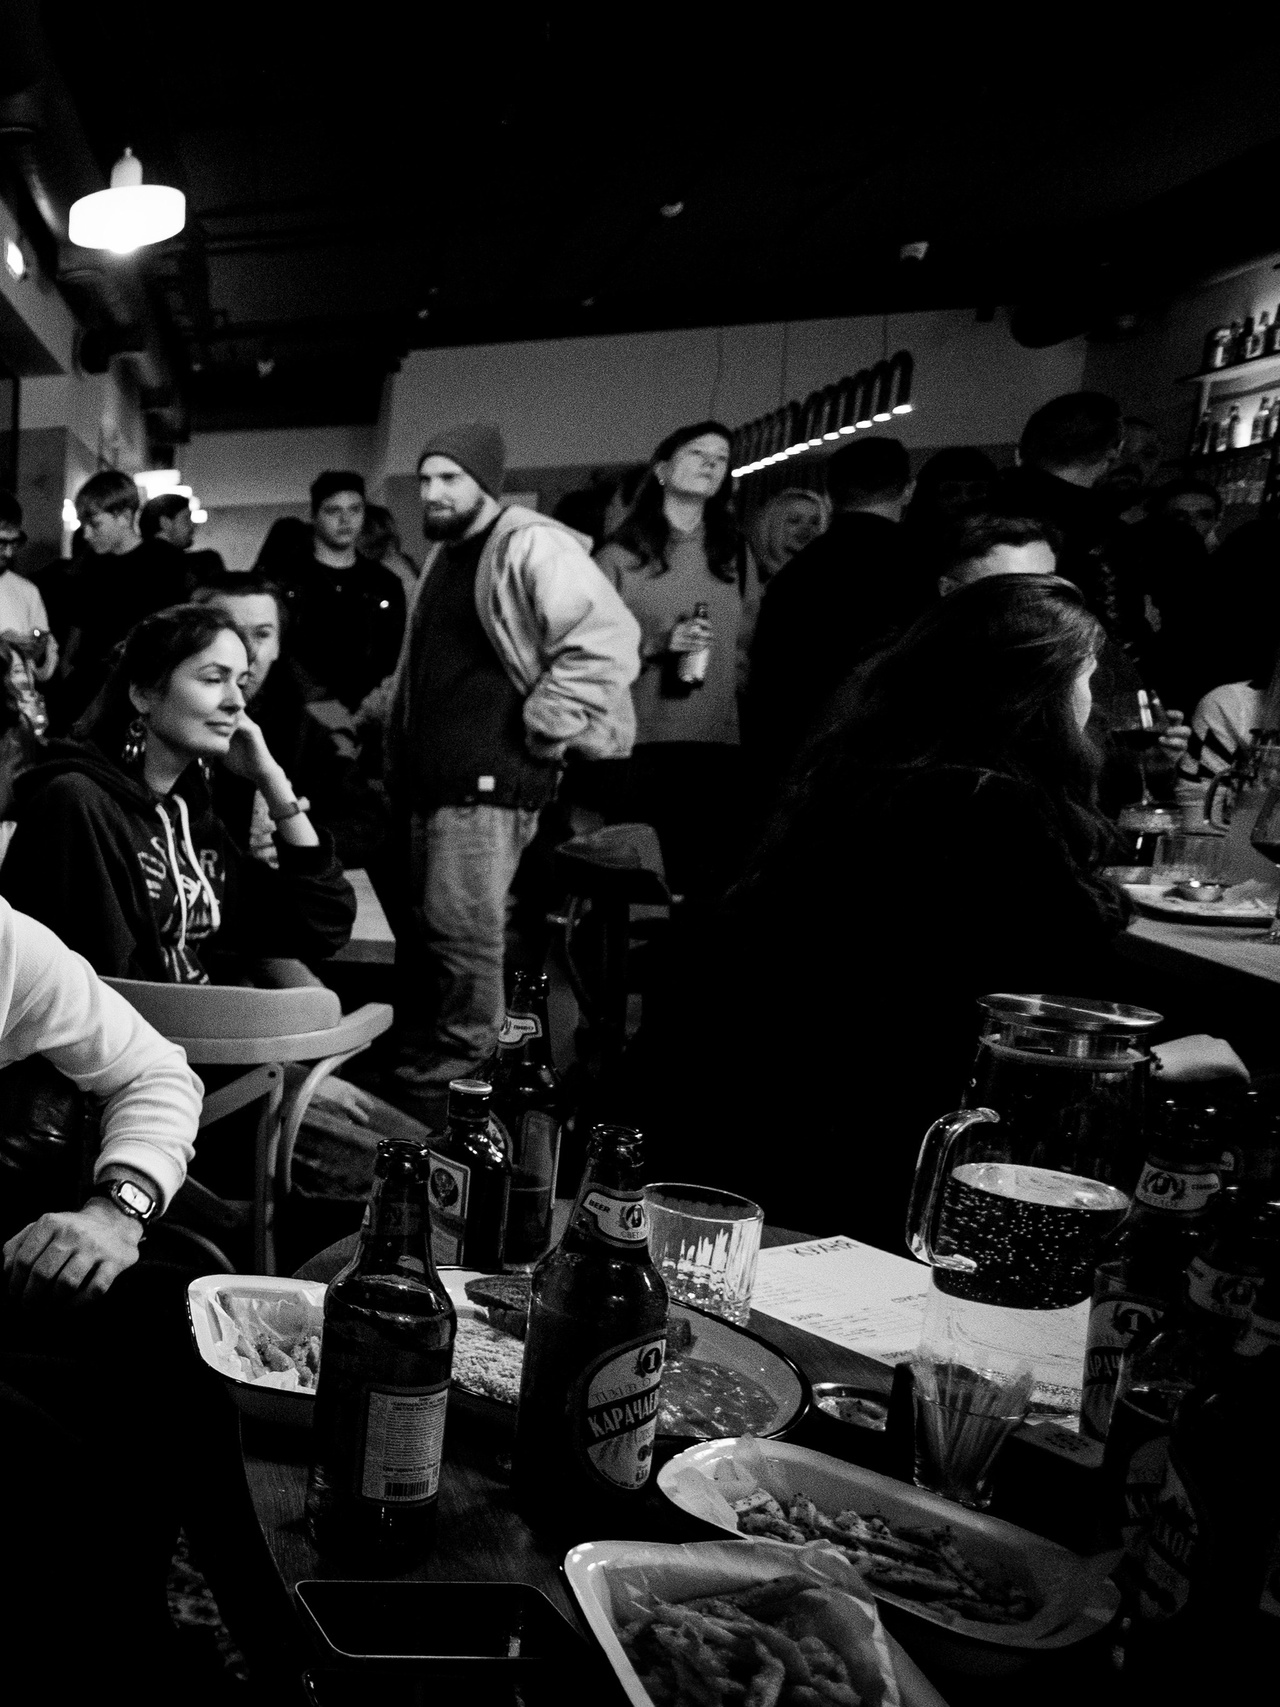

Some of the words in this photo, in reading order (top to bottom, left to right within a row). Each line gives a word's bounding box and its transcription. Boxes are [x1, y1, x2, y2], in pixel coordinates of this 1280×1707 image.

[588, 1199, 611, 1213] BEER
[787, 1238, 859, 1258] КУХНЯ
[586, 1390, 658, 1439] КАРАЧАЕ
